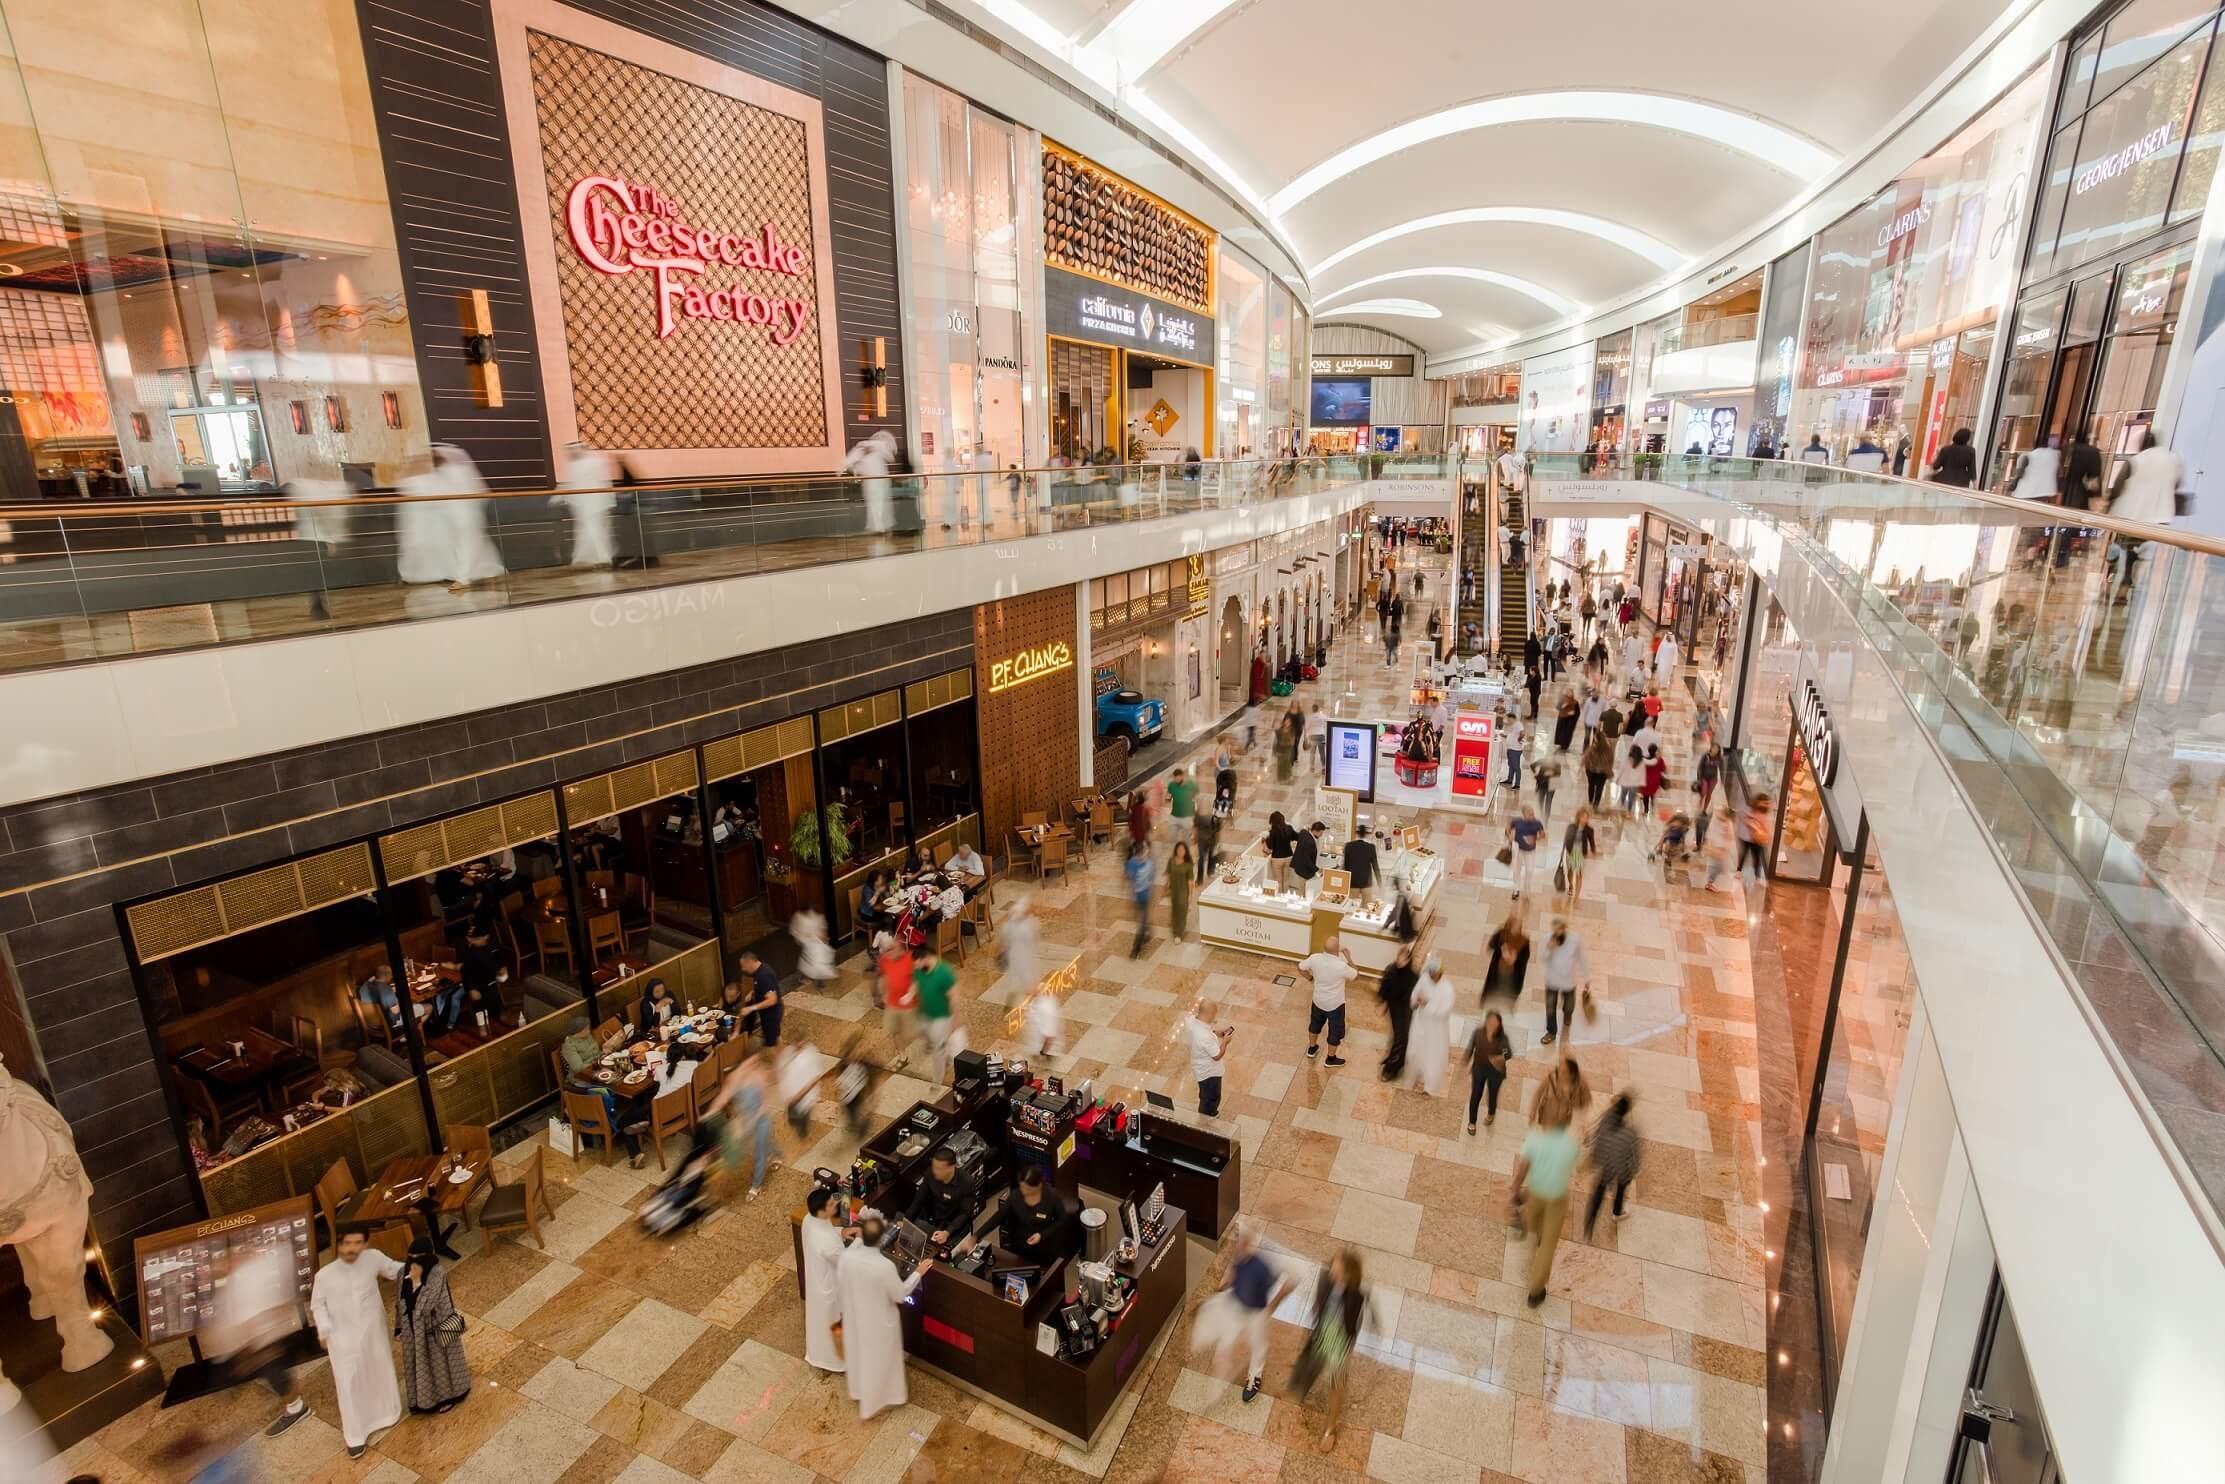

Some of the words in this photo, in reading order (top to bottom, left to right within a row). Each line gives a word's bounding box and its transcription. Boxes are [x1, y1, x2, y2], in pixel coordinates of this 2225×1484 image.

[2076, 153, 2118, 195] GEORG
[2117, 121, 2174, 176] JENSEN
[634, 186, 679, 218] The
[566, 175, 809, 276] Cheesecake
[1878, 200, 1932, 247] CLARINS
[629, 250, 810, 346] Factory
[1462, 757, 1481, 766] FREE
[1235, 927, 1271, 941] LOOTAH
[1011, 1126, 1049, 1146] NESPRESSO
